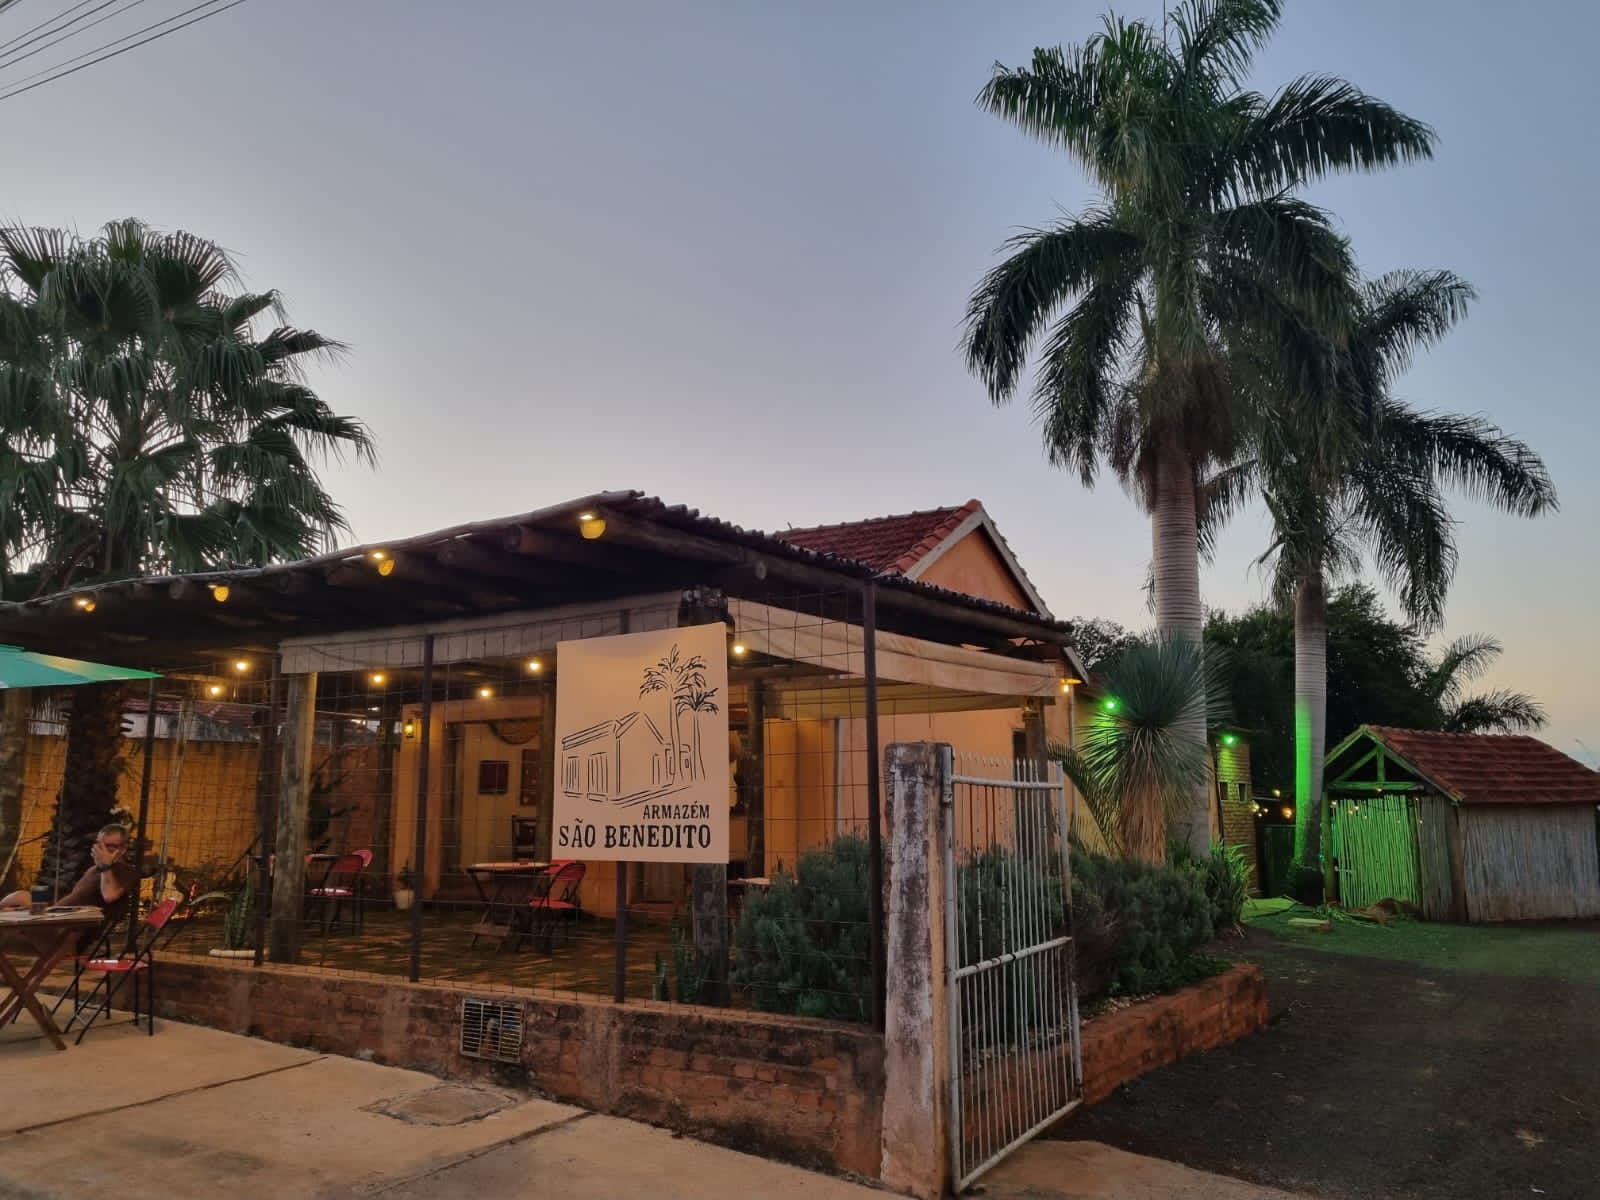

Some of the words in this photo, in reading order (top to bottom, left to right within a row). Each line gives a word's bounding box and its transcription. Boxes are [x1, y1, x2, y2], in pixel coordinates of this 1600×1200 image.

[643, 801, 709, 820] ARMAZÉM
[559, 818, 596, 847] SÃO
[605, 824, 711, 848] BENEDITO
